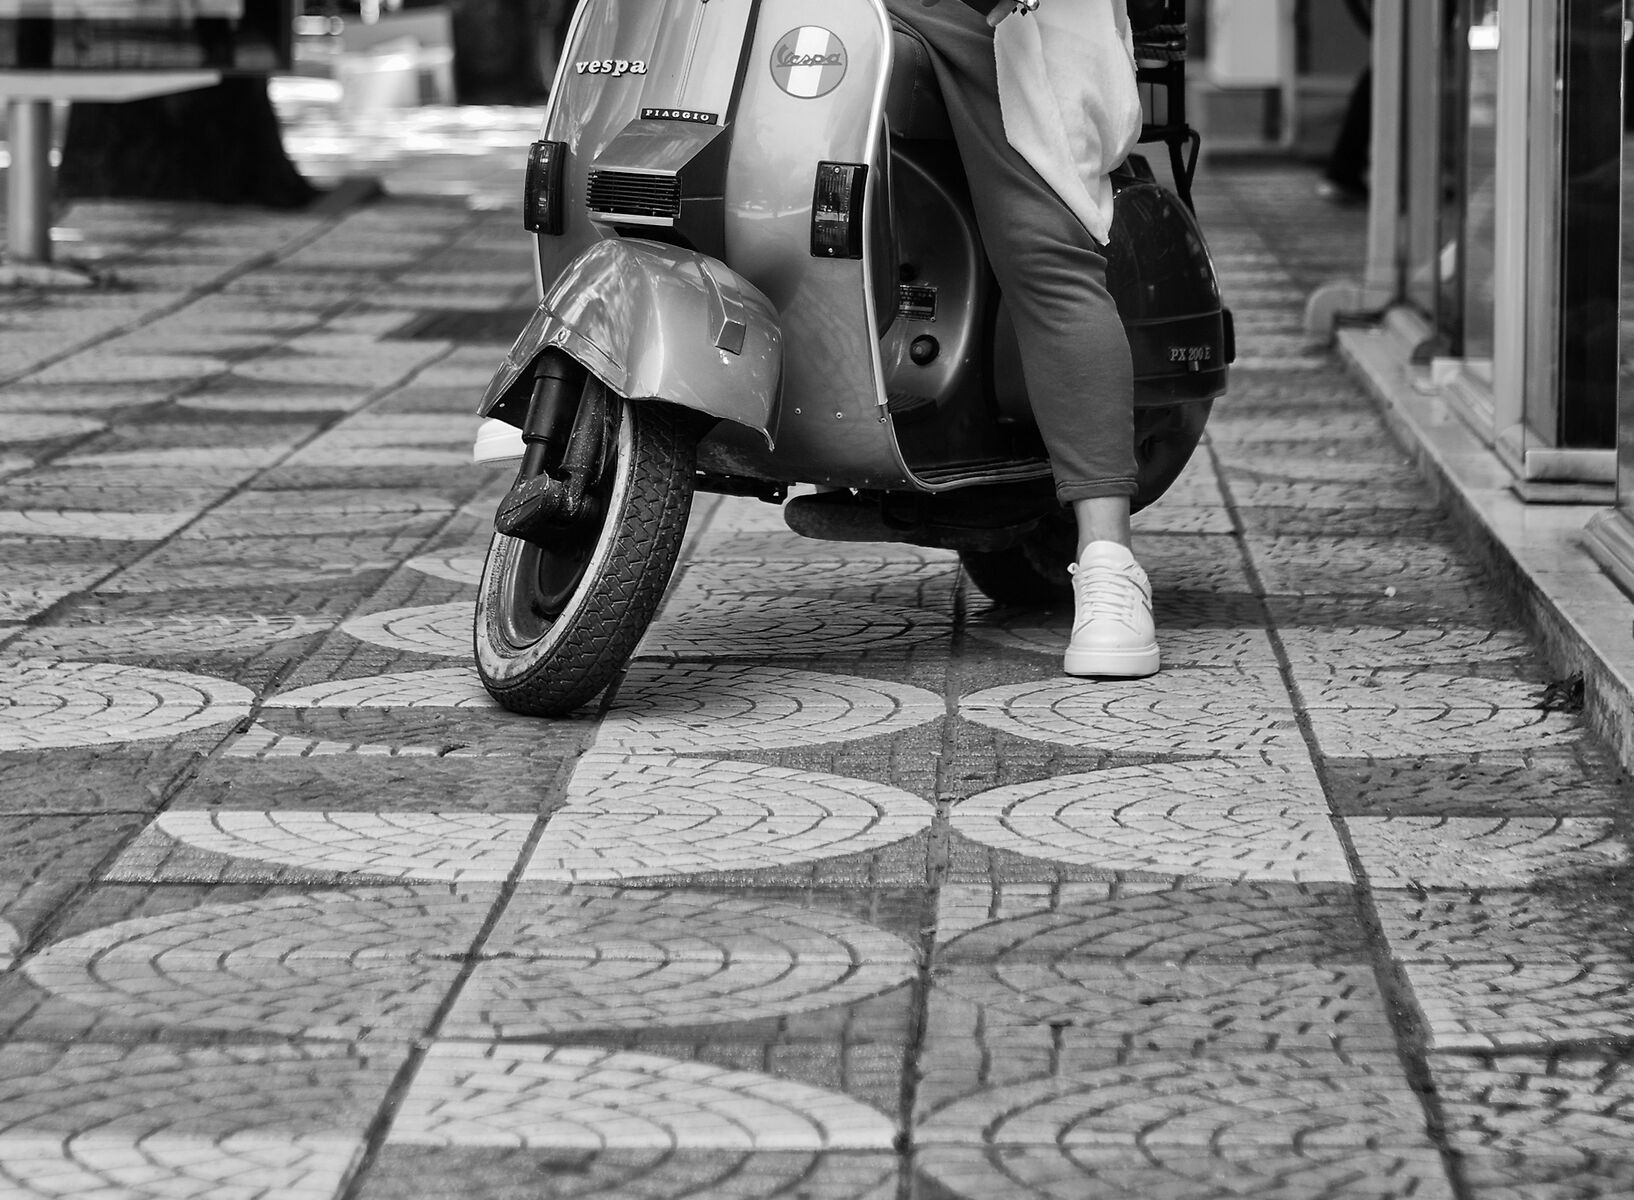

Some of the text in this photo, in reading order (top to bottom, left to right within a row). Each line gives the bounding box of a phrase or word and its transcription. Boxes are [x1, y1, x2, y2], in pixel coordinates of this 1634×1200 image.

[776, 44, 843, 67] Vespa
[575, 58, 648, 77] vespa
[645, 109, 710, 122] PIAGGIO
[1170, 348, 1186, 361] PX
[1204, 347, 1211, 360] E
